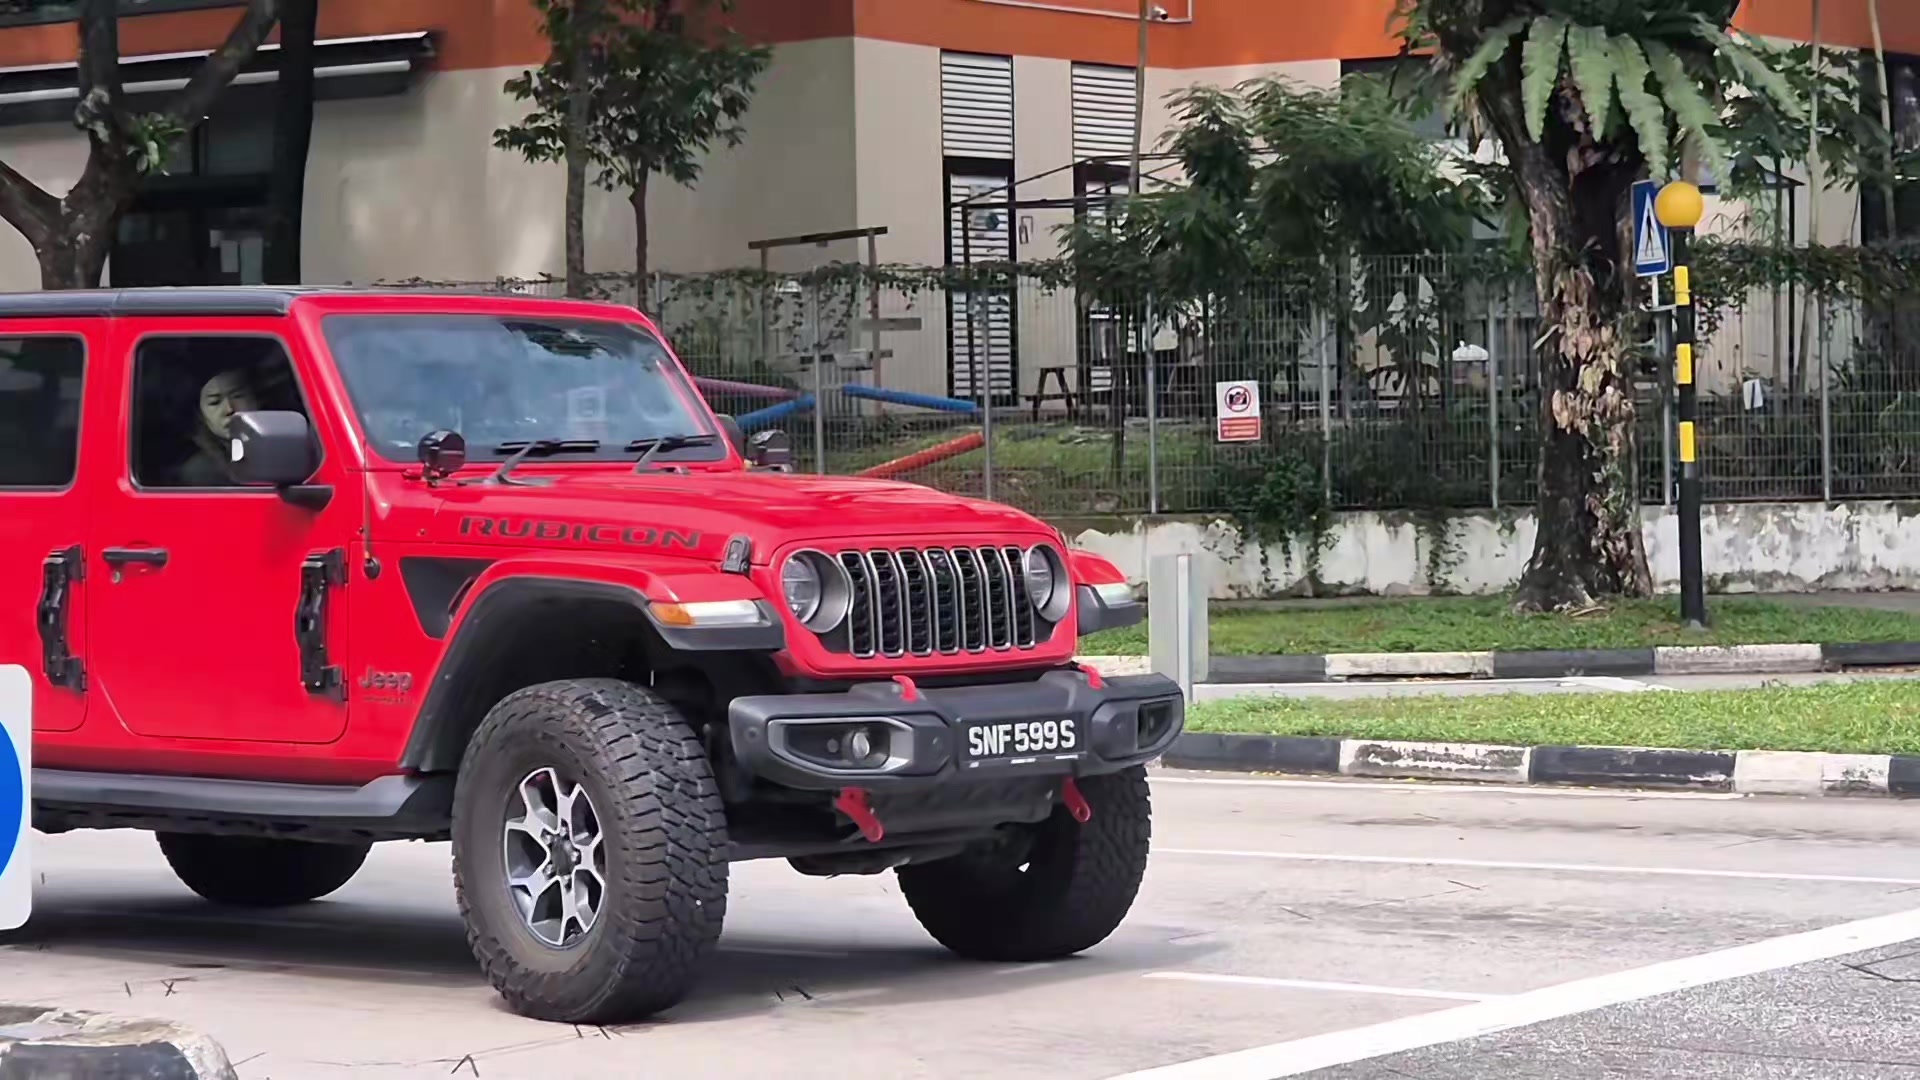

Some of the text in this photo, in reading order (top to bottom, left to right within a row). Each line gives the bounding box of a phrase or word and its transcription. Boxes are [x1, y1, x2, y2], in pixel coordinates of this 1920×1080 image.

[459, 515, 701, 549] RUBICON
[359, 666, 412, 694] Jeep
[968, 719, 1076, 756] SNF599S
